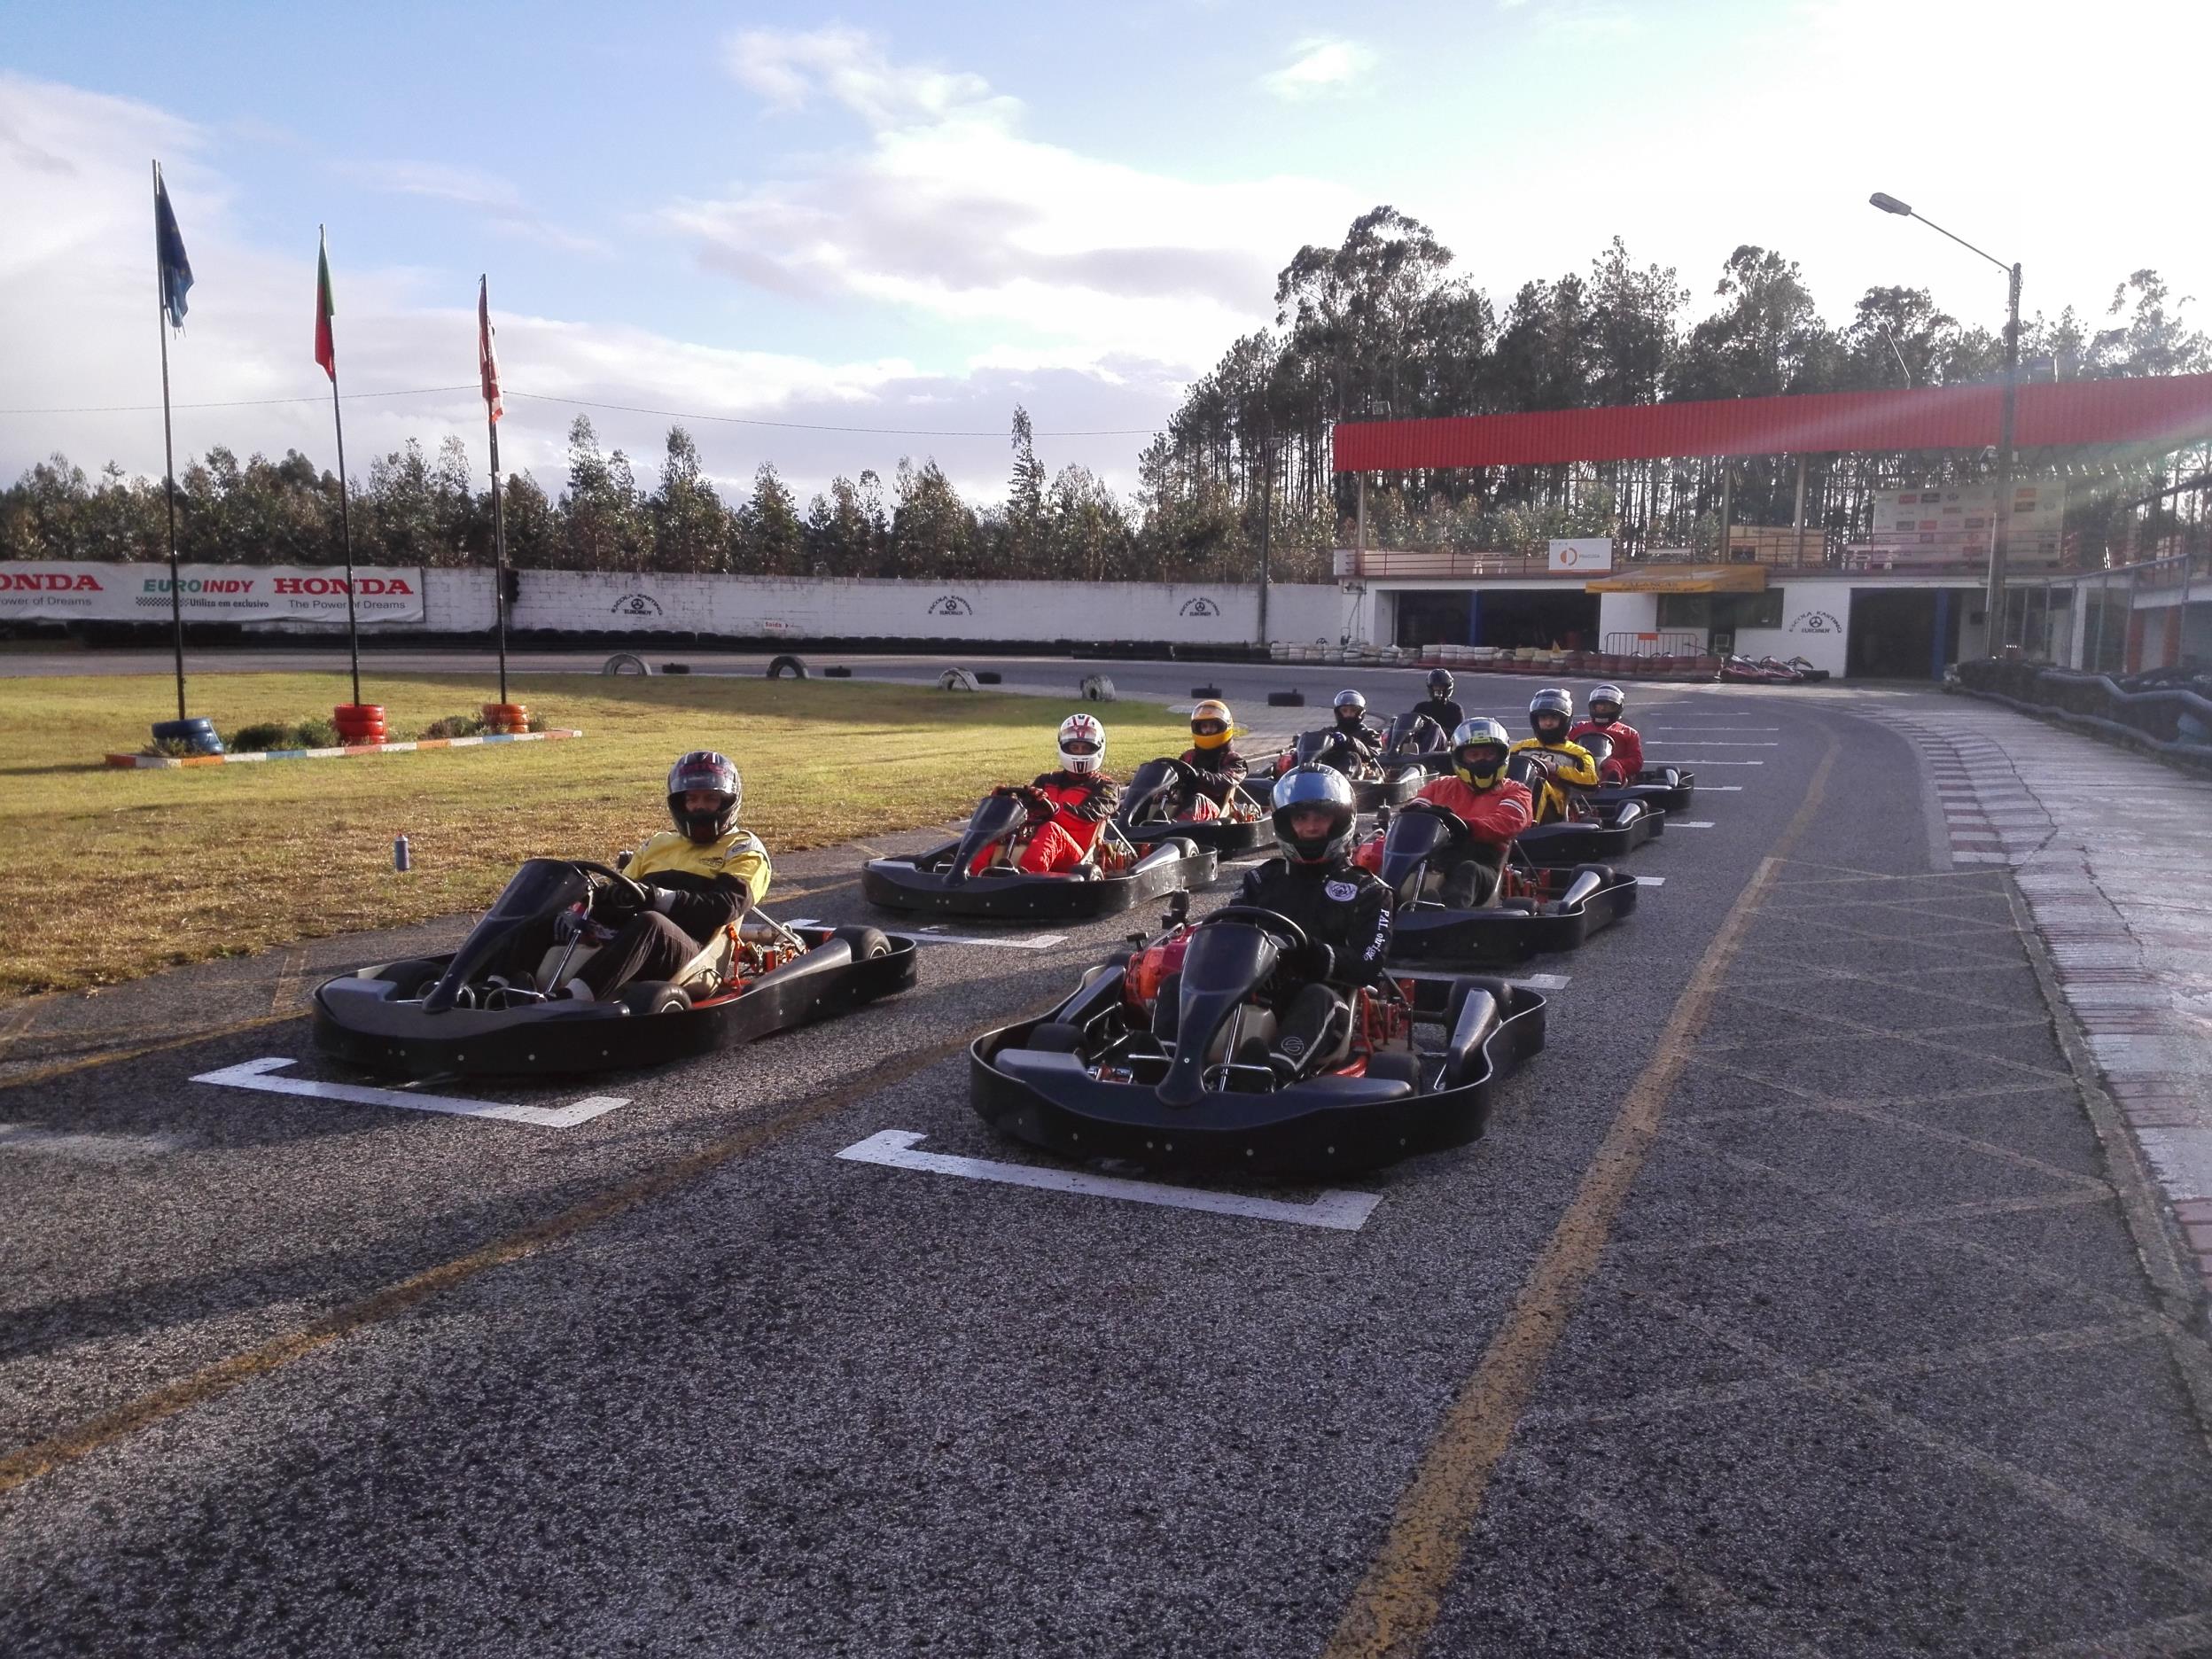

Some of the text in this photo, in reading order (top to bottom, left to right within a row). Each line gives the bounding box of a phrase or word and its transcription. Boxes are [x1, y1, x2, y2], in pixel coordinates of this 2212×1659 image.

[143, 579, 254, 593] EUROINDY
[273, 578, 414, 595] HONDA
[33, 596, 43, 605] of
[47, 596, 92, 606] Dreams
[190, 598, 216, 607] Utiliza
[233, 599, 269, 608] exclusivo
[289, 600, 309, 609] The
[313, 600, 347, 609] Power
[1789, 611, 1842, 633] ESCOLA KARTING
